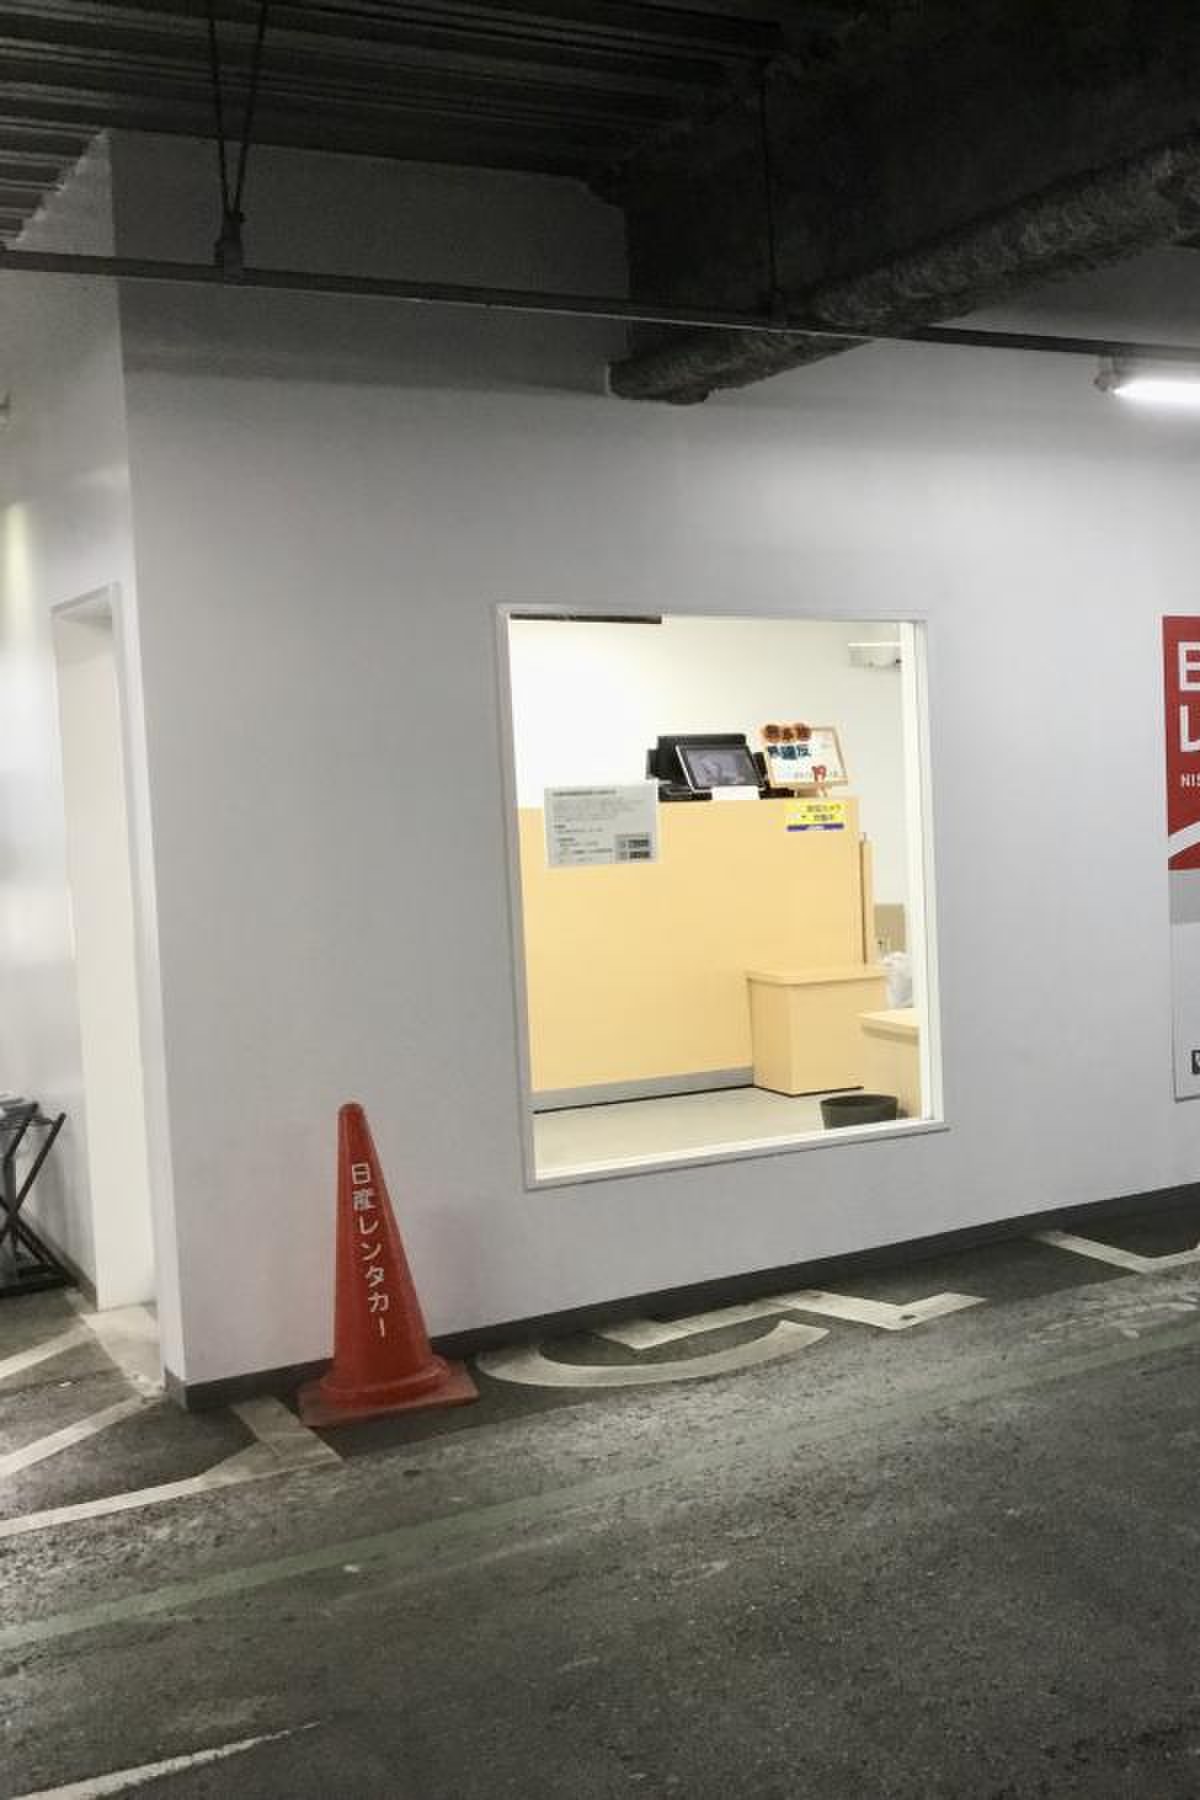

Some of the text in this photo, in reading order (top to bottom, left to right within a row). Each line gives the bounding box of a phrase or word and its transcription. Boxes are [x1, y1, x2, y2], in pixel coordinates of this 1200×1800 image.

[351, 1162, 389, 1337] 日産レンタカー
